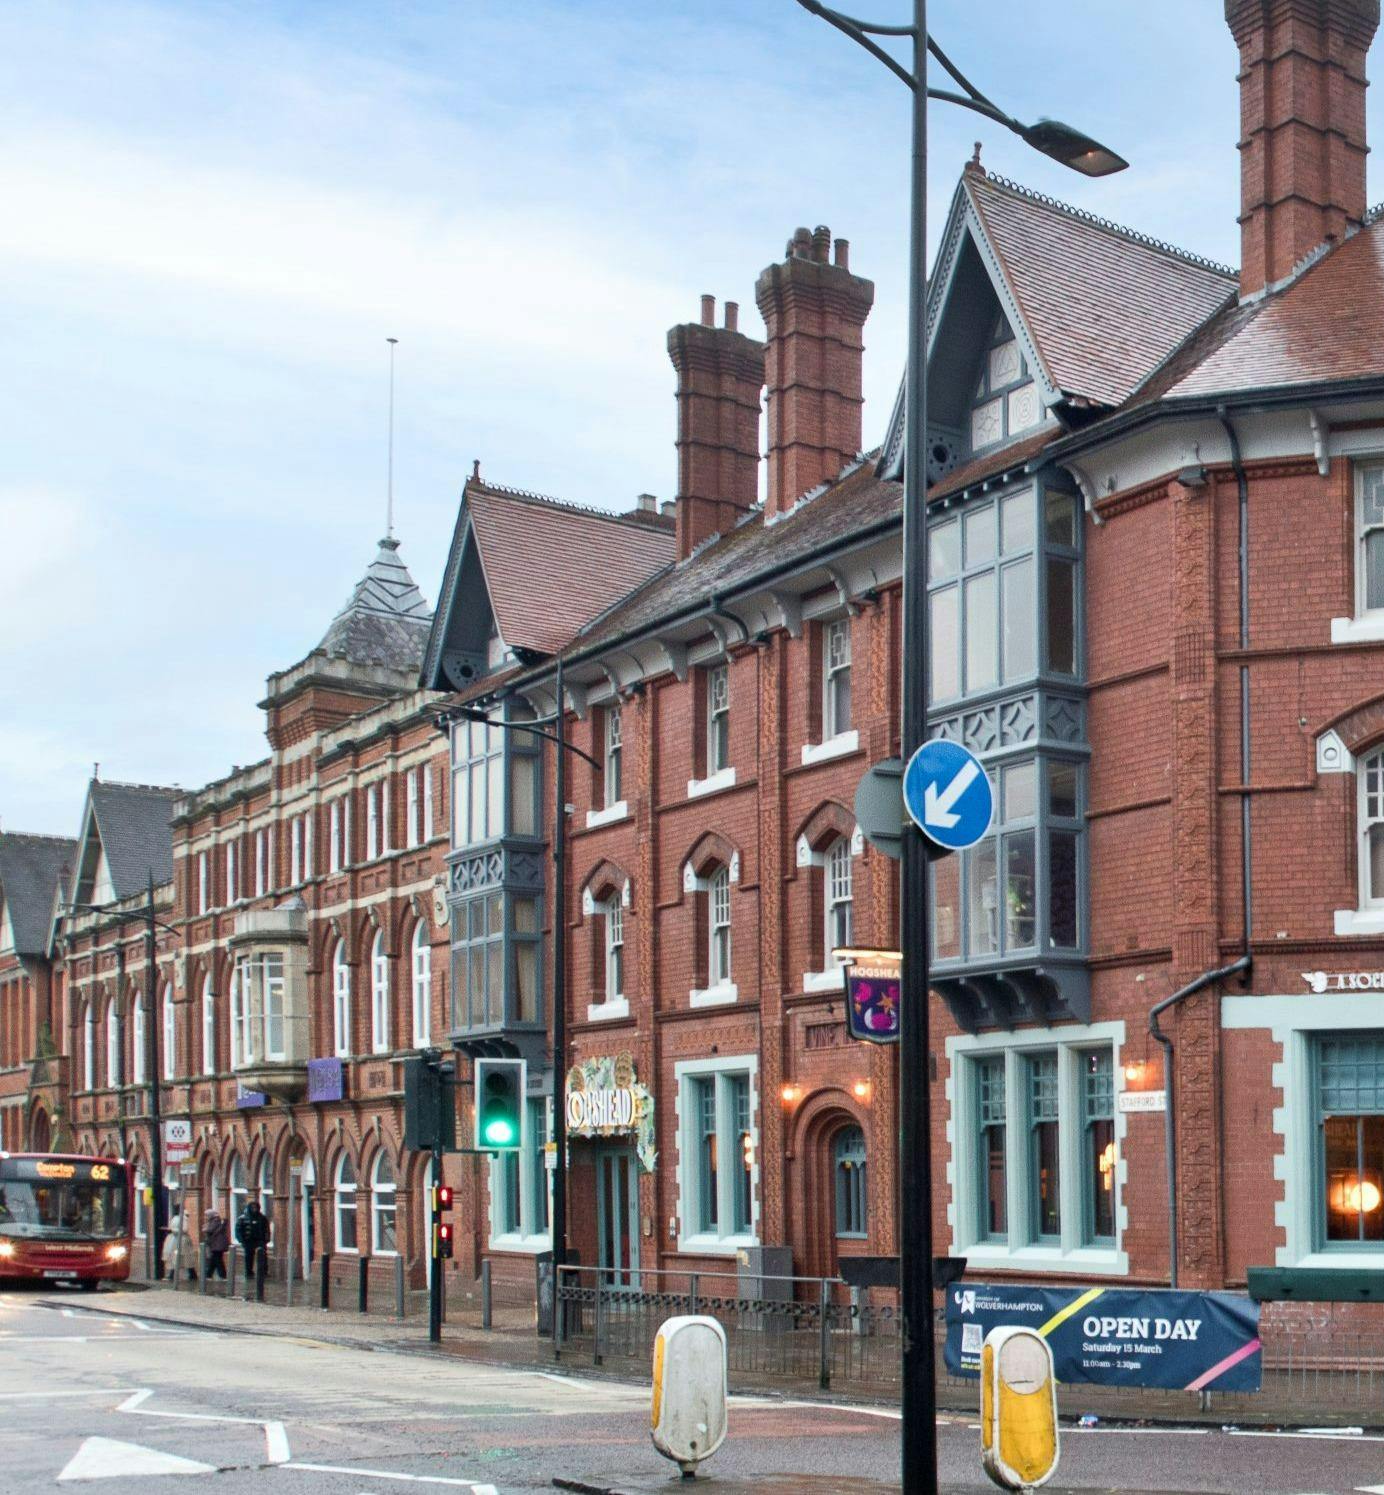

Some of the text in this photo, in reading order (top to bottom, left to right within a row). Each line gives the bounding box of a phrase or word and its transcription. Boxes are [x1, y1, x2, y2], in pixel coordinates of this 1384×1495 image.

[849, 967, 900, 978] HOGSHEA
[1121, 1095, 1155, 1108] STAFFORD
[91, 1165, 110, 1180] 62
[975, 1301, 1043, 1311] WOLVERHAMPTON
[1083, 1316, 1202, 1340] OPEN DAY
[1082, 1342, 1162, 1354] Saturday 15 March
[1116, 1361, 1141, 1370] 2.30pm
